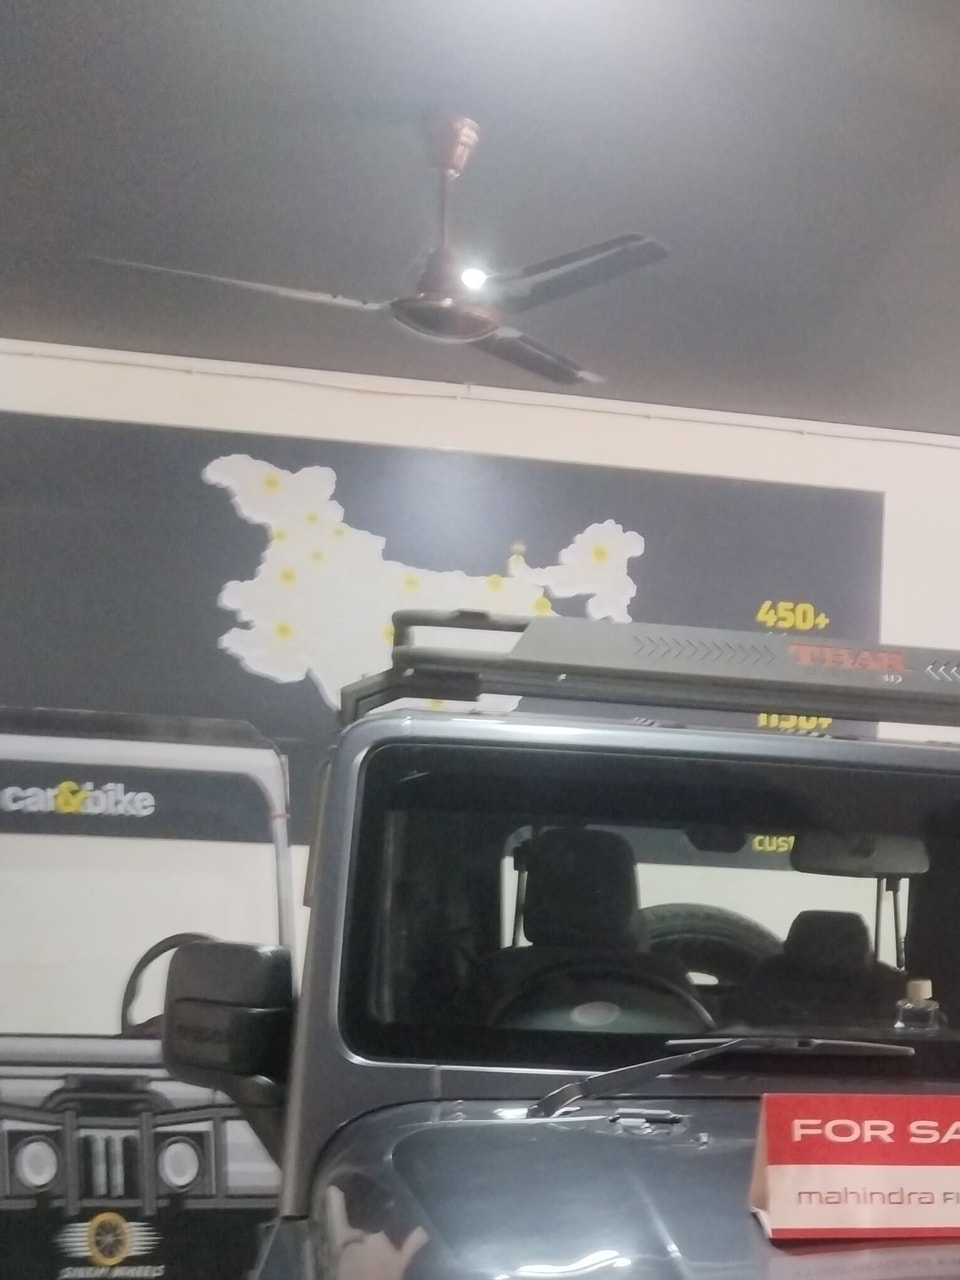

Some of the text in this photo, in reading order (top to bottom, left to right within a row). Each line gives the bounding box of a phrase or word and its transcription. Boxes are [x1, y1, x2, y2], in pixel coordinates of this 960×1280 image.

[756, 600, 829, 630] 450+
[0, 780, 156, 818] car&bike
[791, 1118, 895, 1144] FOR
[797, 1186, 935, 1205] mahindra
